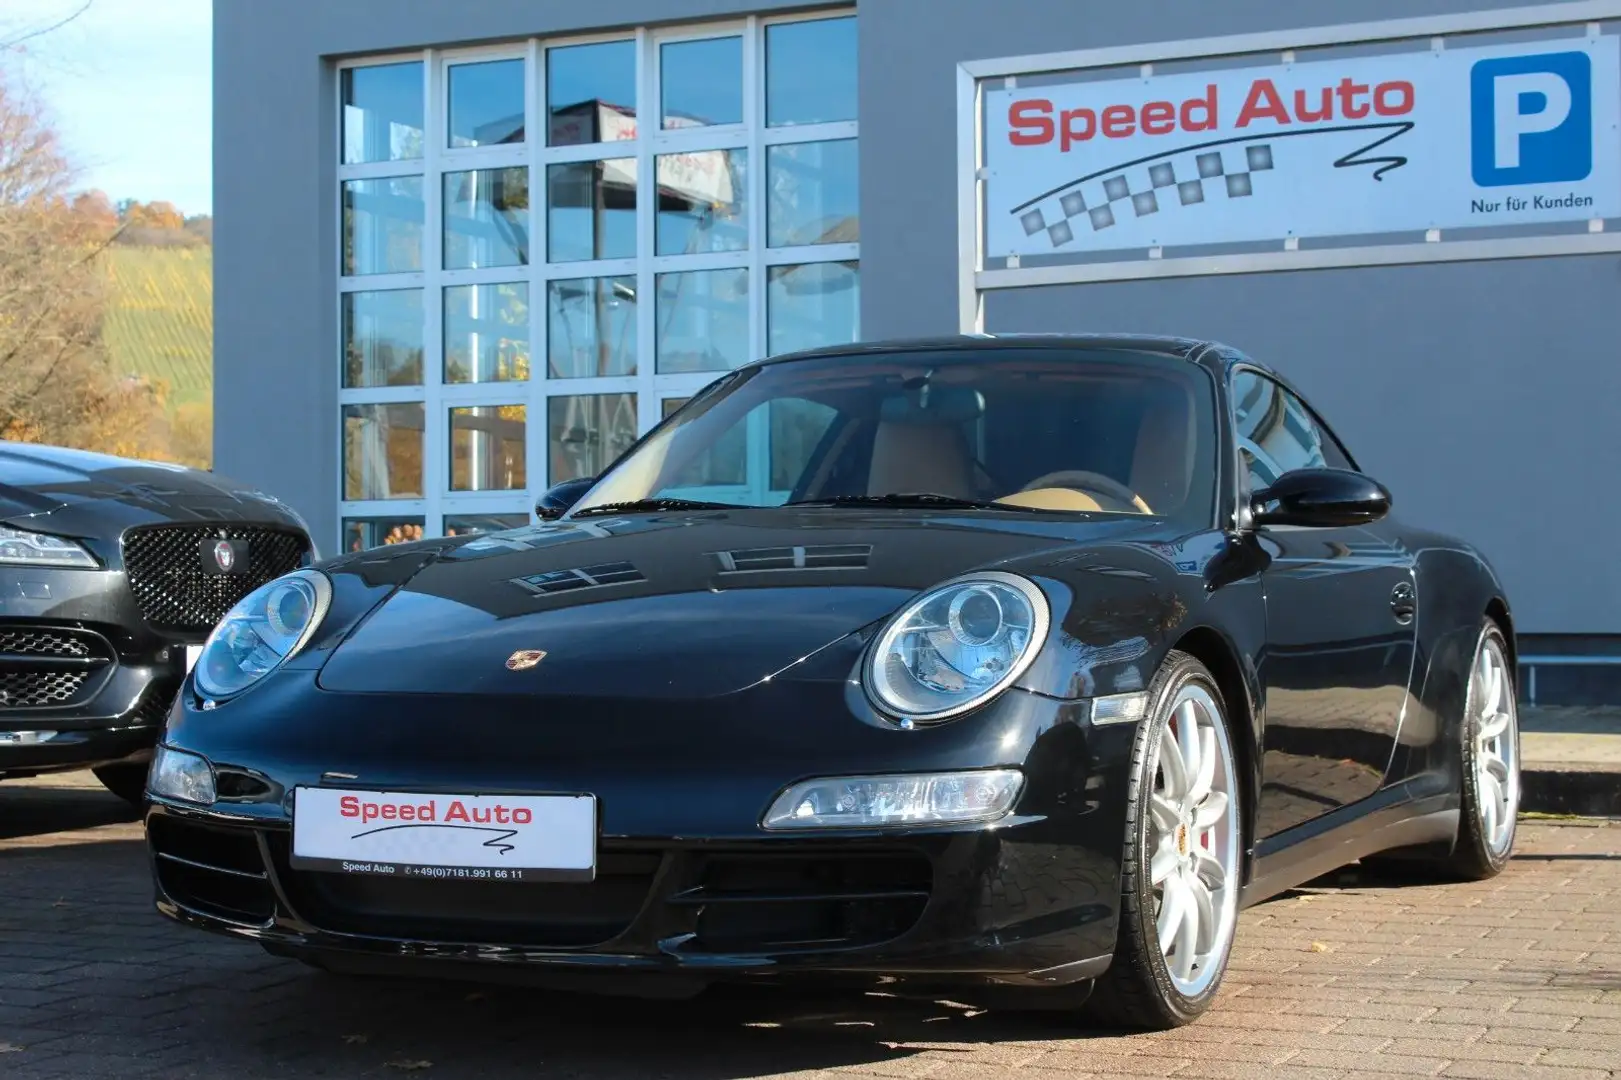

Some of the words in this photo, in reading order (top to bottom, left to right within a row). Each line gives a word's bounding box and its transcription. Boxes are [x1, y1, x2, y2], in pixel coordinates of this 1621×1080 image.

[1008, 84, 1218, 152] Speed
[1235, 79, 1415, 128] Auto
[1493, 71, 1572, 169] P
[1471, 198, 1502, 213] Nur
[1505, 195, 1529, 212] für
[1533, 192, 1594, 210] Kunden
[340, 796, 436, 824] Speed
[444, 801, 533, 825] Auto
[342, 861, 371, 873] Speed
[373, 864, 395, 874] Auto
[413, 867, 491, 878] +49(0)7181.991
[494, 870, 508, 879] 66
[511, 871, 523, 879] 11
